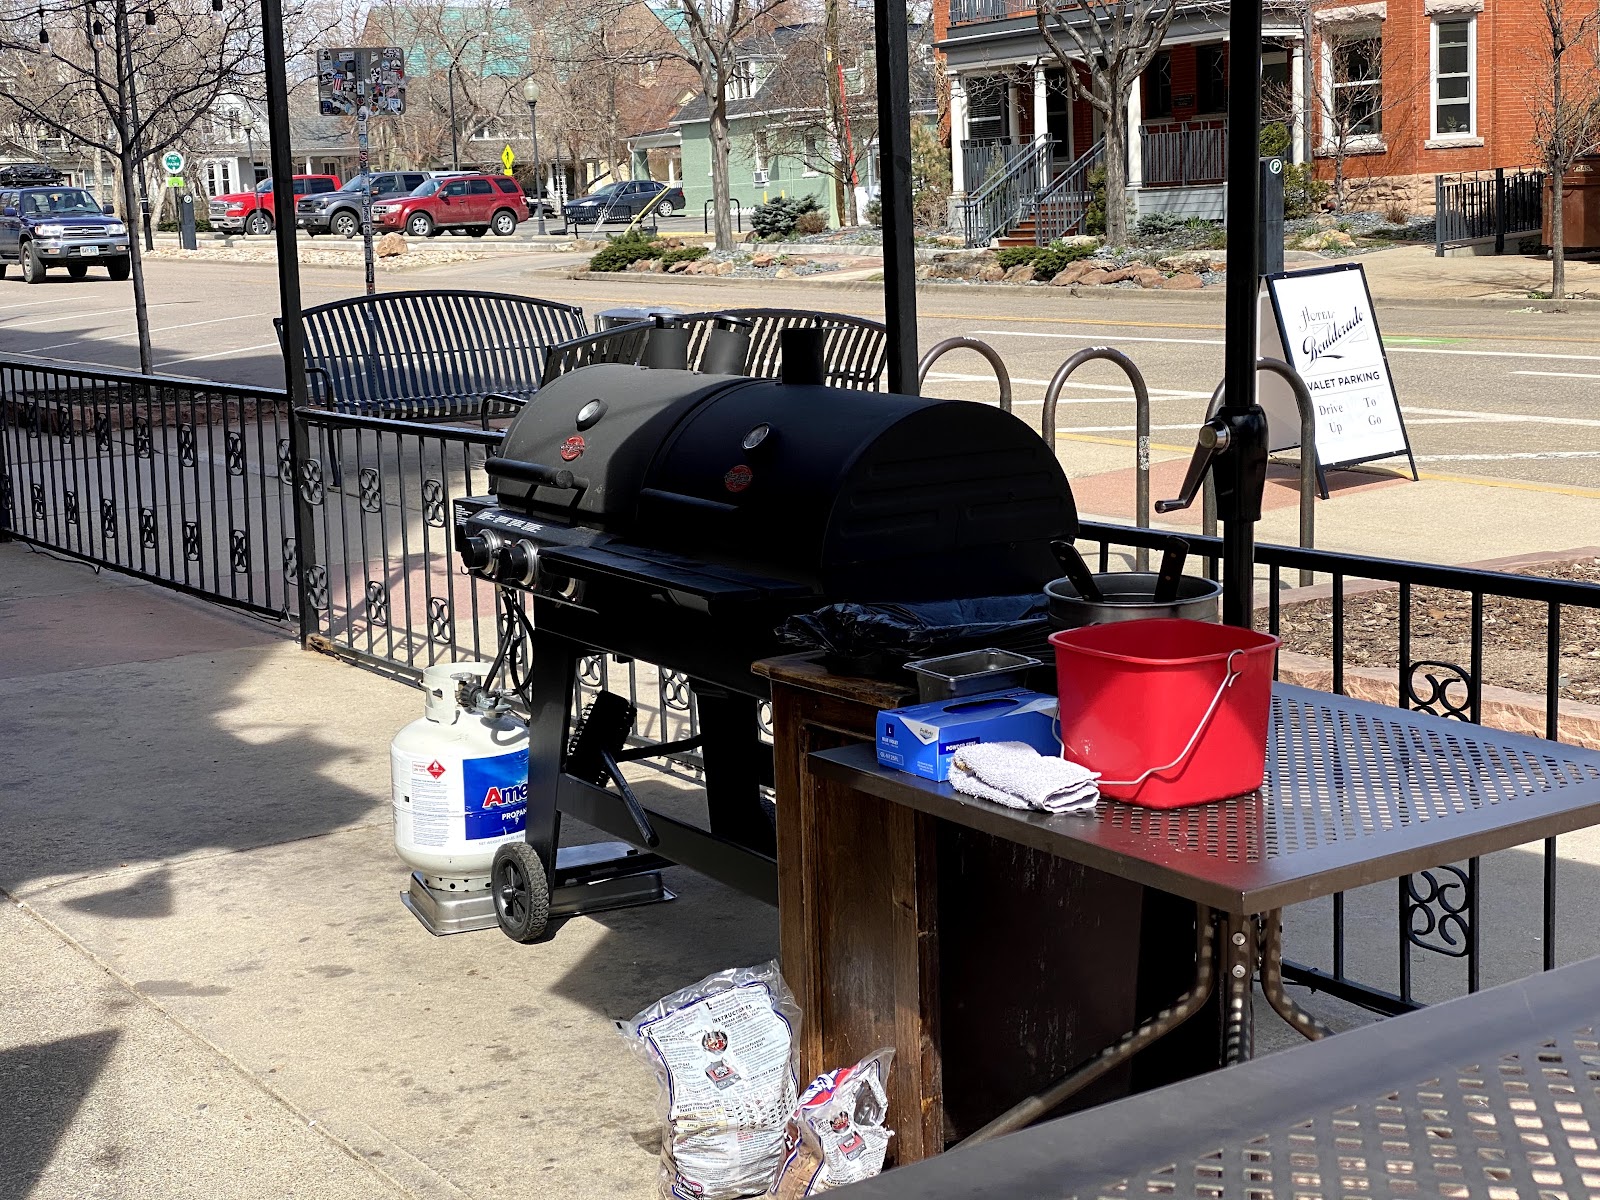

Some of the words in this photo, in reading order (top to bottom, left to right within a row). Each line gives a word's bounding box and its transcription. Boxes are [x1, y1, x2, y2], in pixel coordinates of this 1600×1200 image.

[1307, 378, 1335, 391] VALET
[1338, 371, 1380, 386] PARKING
[1363, 397, 1377, 408] To
[1319, 404, 1343, 416] Drive
[1368, 414, 1382, 426] Go
[1329, 422, 1343, 435] Up
